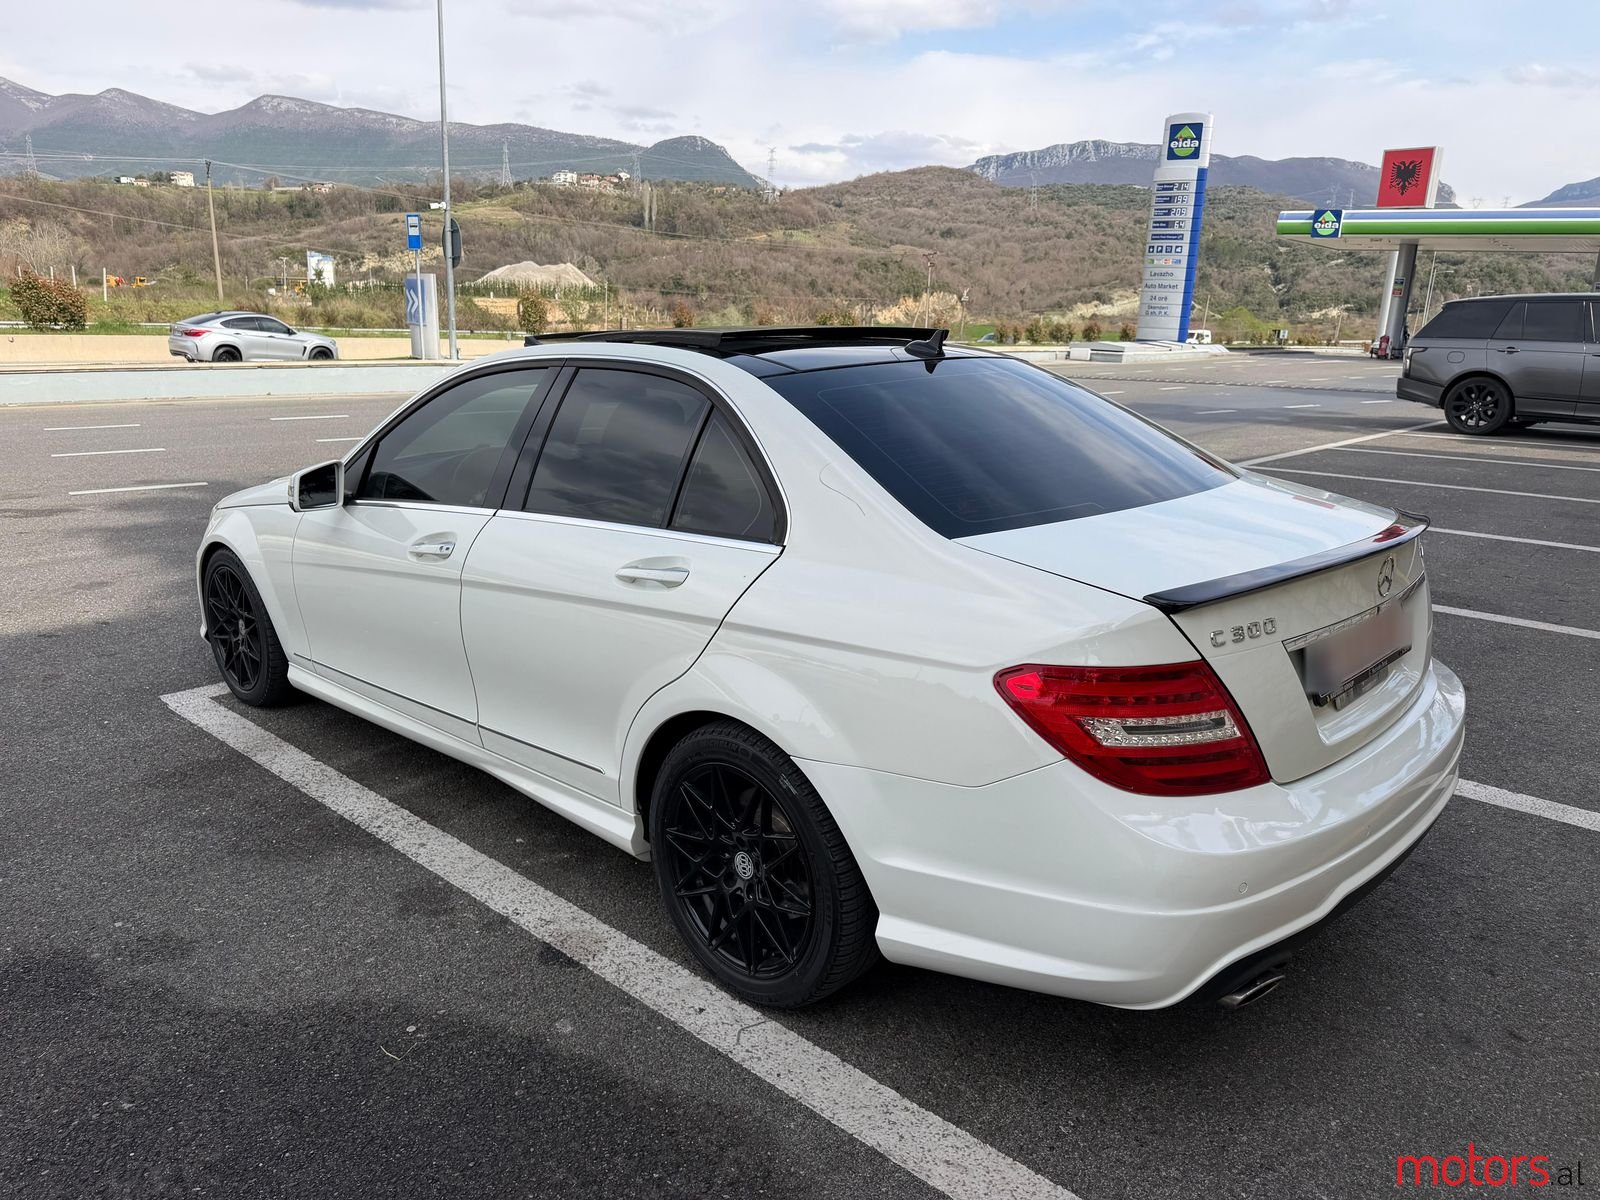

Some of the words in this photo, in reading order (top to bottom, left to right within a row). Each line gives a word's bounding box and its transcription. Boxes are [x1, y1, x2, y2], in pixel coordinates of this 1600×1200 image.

[1170, 138, 1199, 148] eida
[1173, 183, 1190, 191] 214
[1174, 195, 1188, 204] 199
[1170, 208, 1187, 217] 209
[1174, 220, 1185, 229] 64
[1314, 221, 1339, 229] eida
[1210, 630, 1226, 648] C
[1231, 617, 1277, 644] 300
